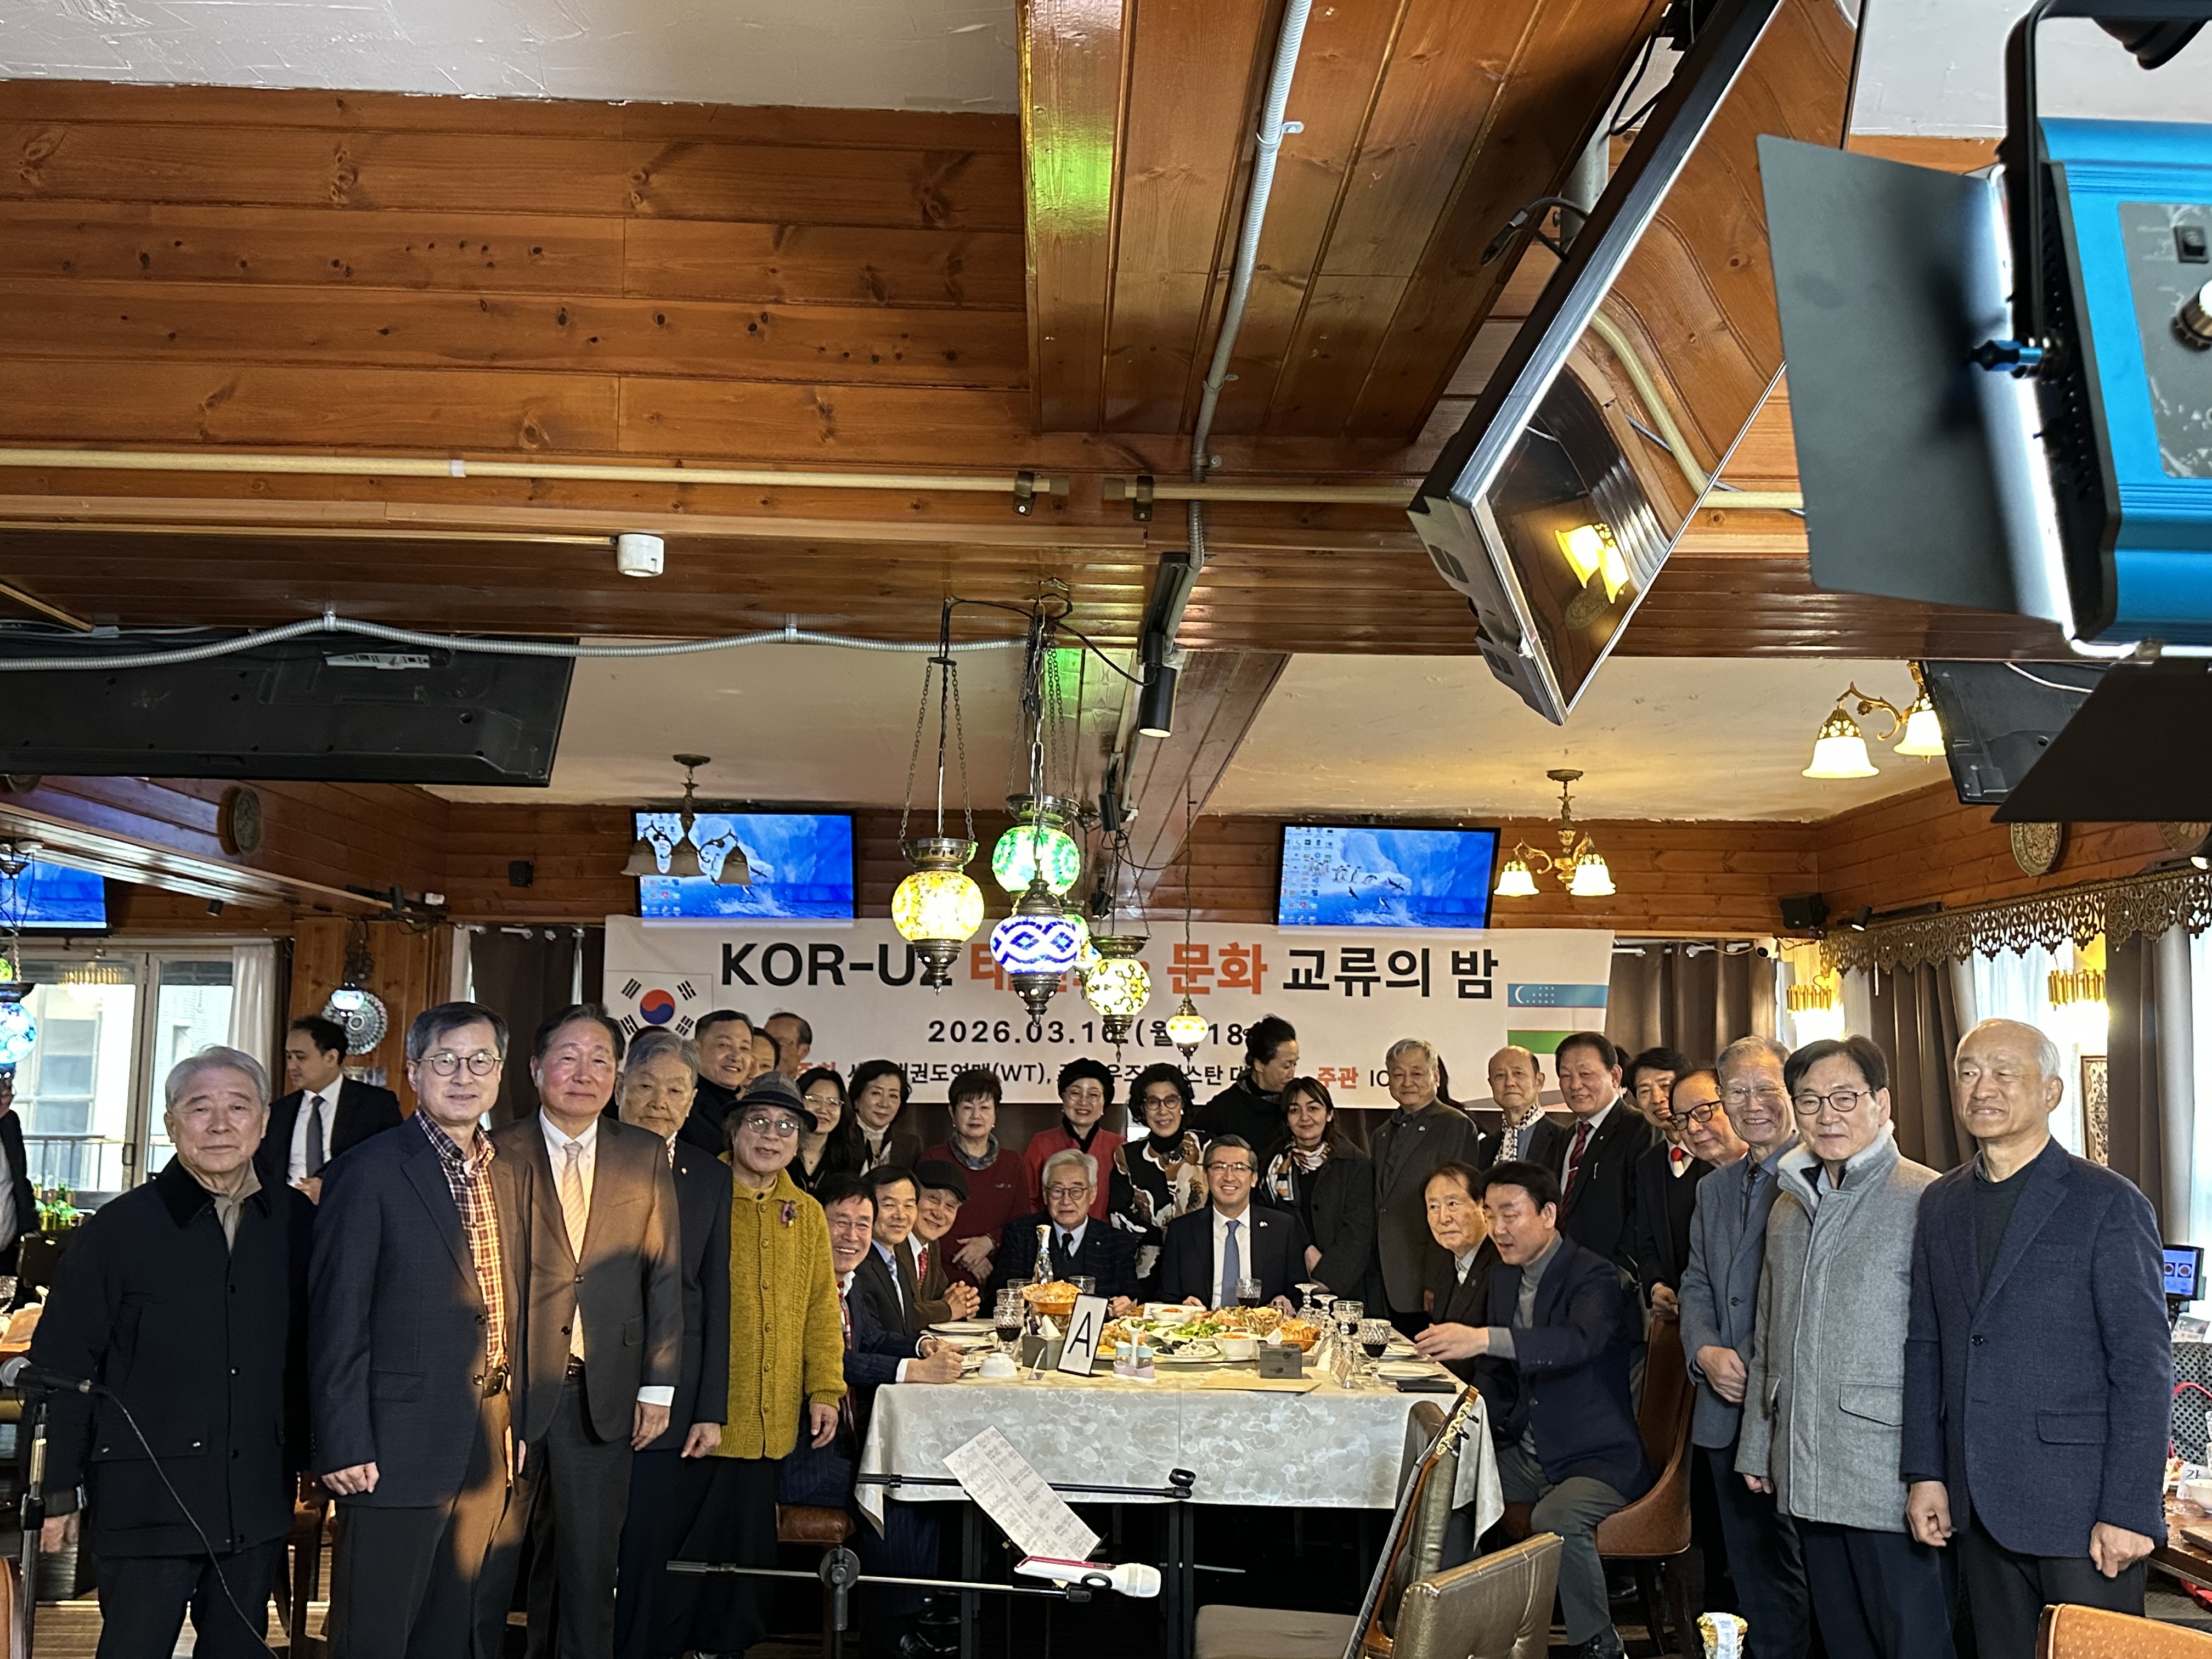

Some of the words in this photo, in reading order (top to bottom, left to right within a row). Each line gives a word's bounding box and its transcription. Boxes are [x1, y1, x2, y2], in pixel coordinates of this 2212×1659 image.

[1166, 942, 1268, 995] 문화
[1283, 947, 1430, 998] 교류의
[1451, 949, 1499, 999] 밤
[1317, 1066, 1359, 1090] 주관
[1066, 1311, 1091, 1358] A
